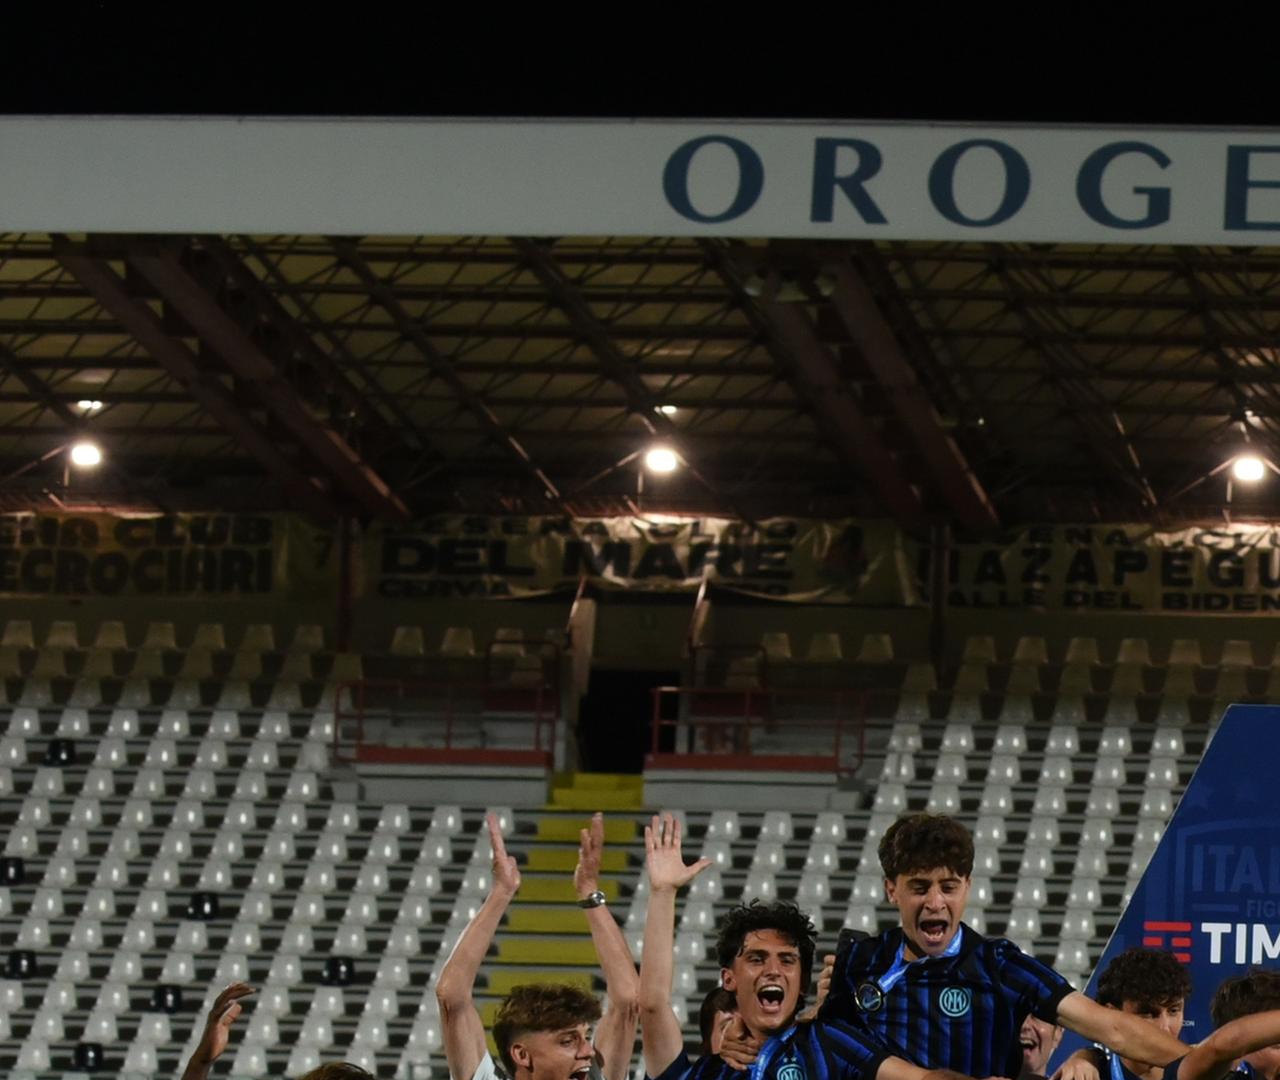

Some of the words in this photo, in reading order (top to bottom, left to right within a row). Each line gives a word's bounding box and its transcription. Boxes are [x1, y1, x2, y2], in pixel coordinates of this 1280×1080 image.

[382, 539, 535, 577] DEL
[563, 541, 794, 580] MARE
[1063, 592, 1144, 611] DEL
